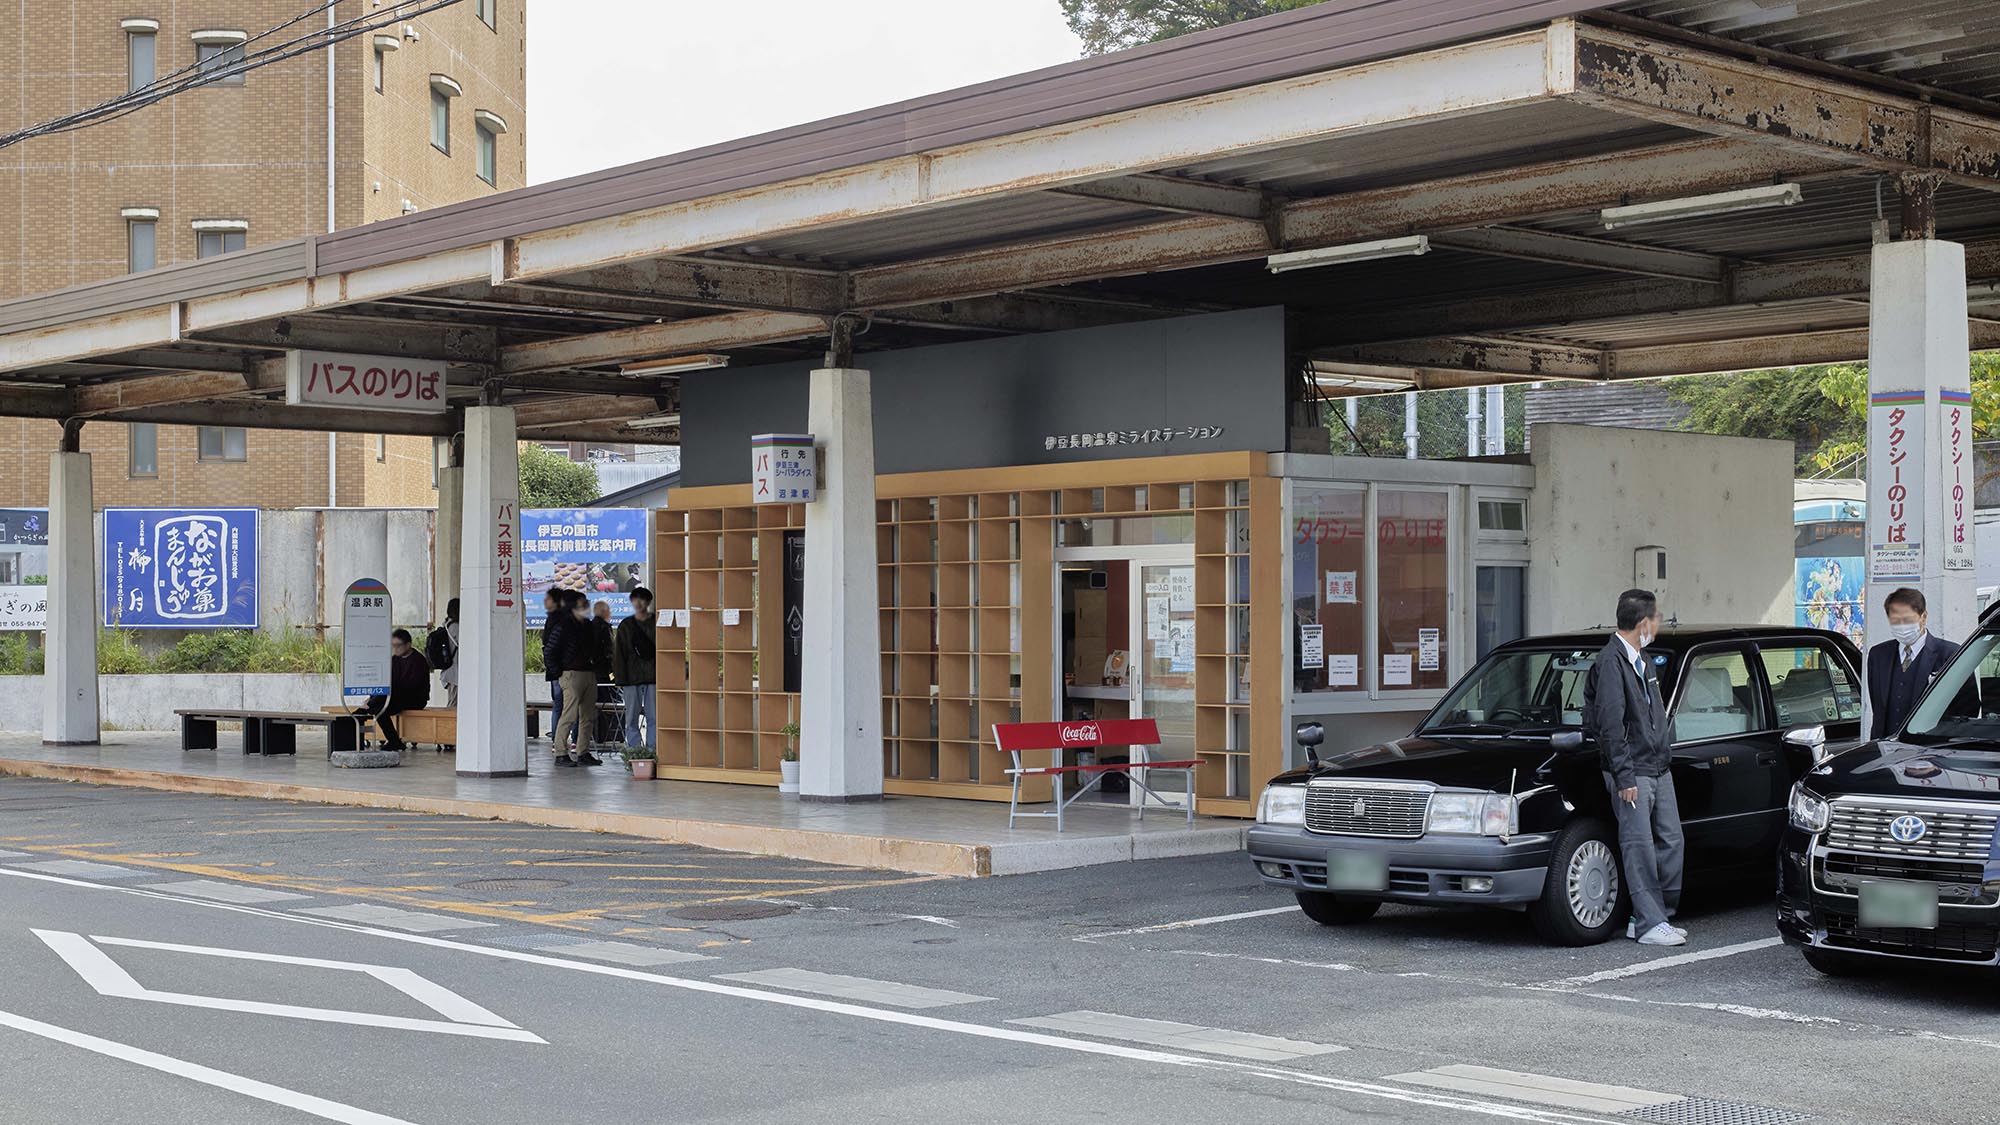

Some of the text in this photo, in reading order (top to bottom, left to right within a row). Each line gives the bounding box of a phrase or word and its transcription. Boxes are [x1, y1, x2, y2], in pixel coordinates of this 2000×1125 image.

[308, 362, 441, 401] バスのりば
[1044, 425, 1224, 450] 伊豆長岡温泉ミライステーション
[757, 454, 768, 495] バス
[776, 469, 812, 477] シーパラダイス
[1887, 407, 1907, 543] タクシーのりば
[1950, 407, 1965, 543] タクシーのりば
[537, 524, 599, 538] 伊豆の国市
[497, 503, 513, 596] バス乗り場
[520, 538, 637, 552] 長岡駅前観光案内所
[166, 527, 190, 613] まんじゅう
[1329, 580, 1353, 595] 禁煙
[0, 599, 48, 615] ぎの風
[350, 597, 384, 607] 温泉駅
[1062, 724, 1098, 742] Coca-Cola
